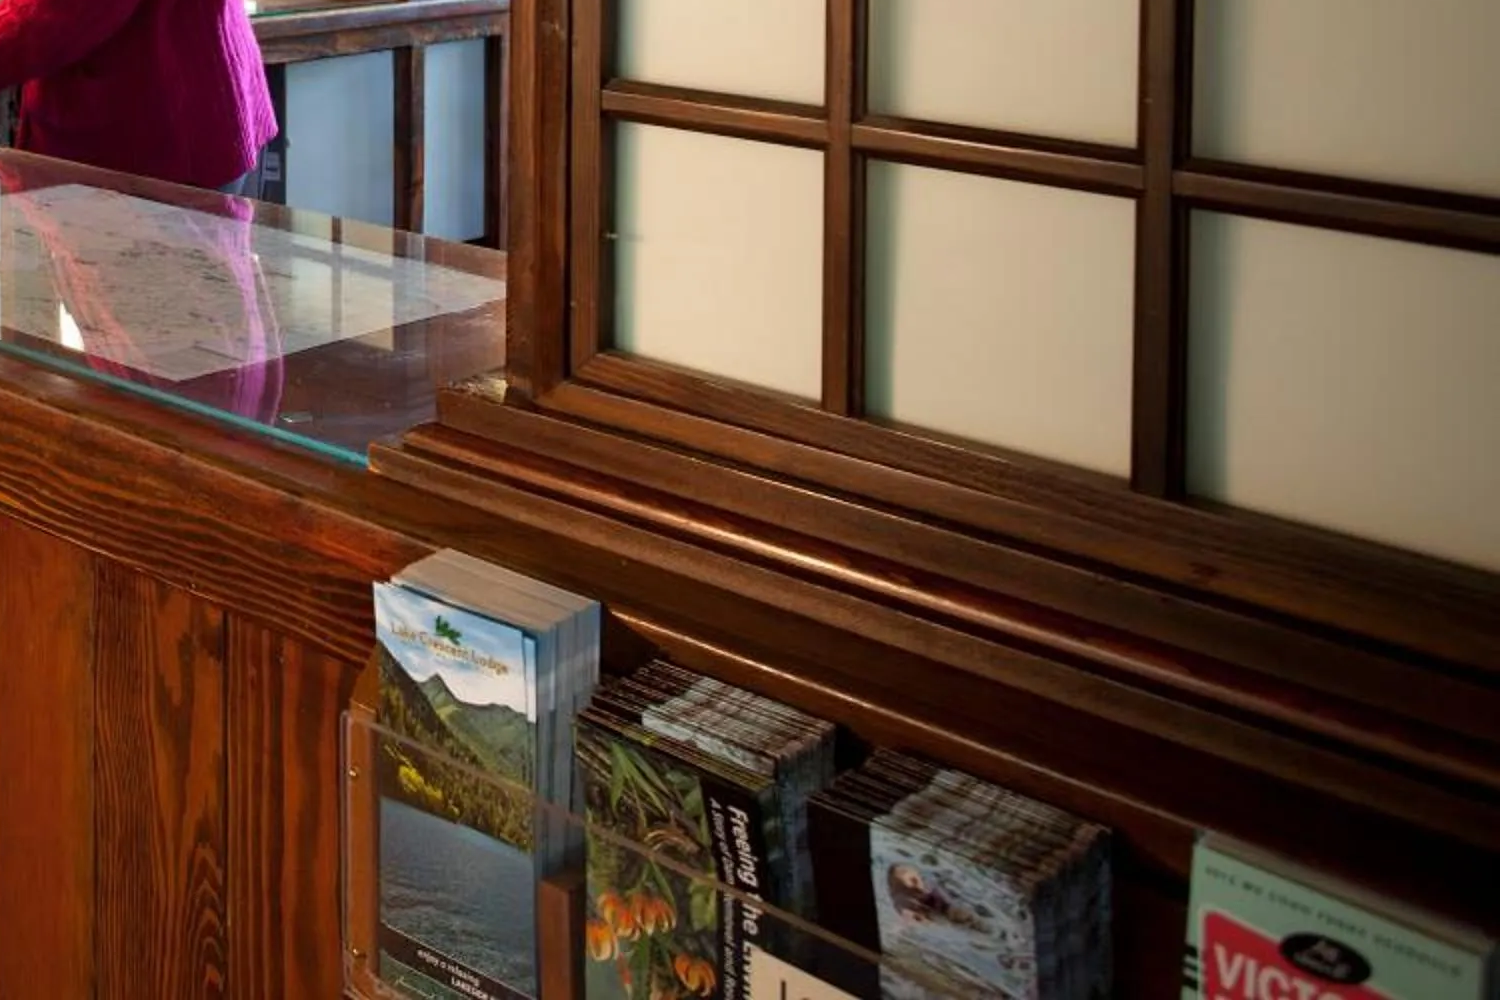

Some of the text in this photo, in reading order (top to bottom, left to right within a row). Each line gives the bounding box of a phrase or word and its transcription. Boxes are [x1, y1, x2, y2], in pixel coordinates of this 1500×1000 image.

[390, 622, 509, 676] Lake Crescent Lodge
[710, 797, 722, 809] A
[711, 809, 726, 840] Story
[718, 841, 732, 858] of
[727, 805, 760, 888] Freeing
[721, 855, 735, 885] Dam
[447, 964, 480, 988] relaxing
